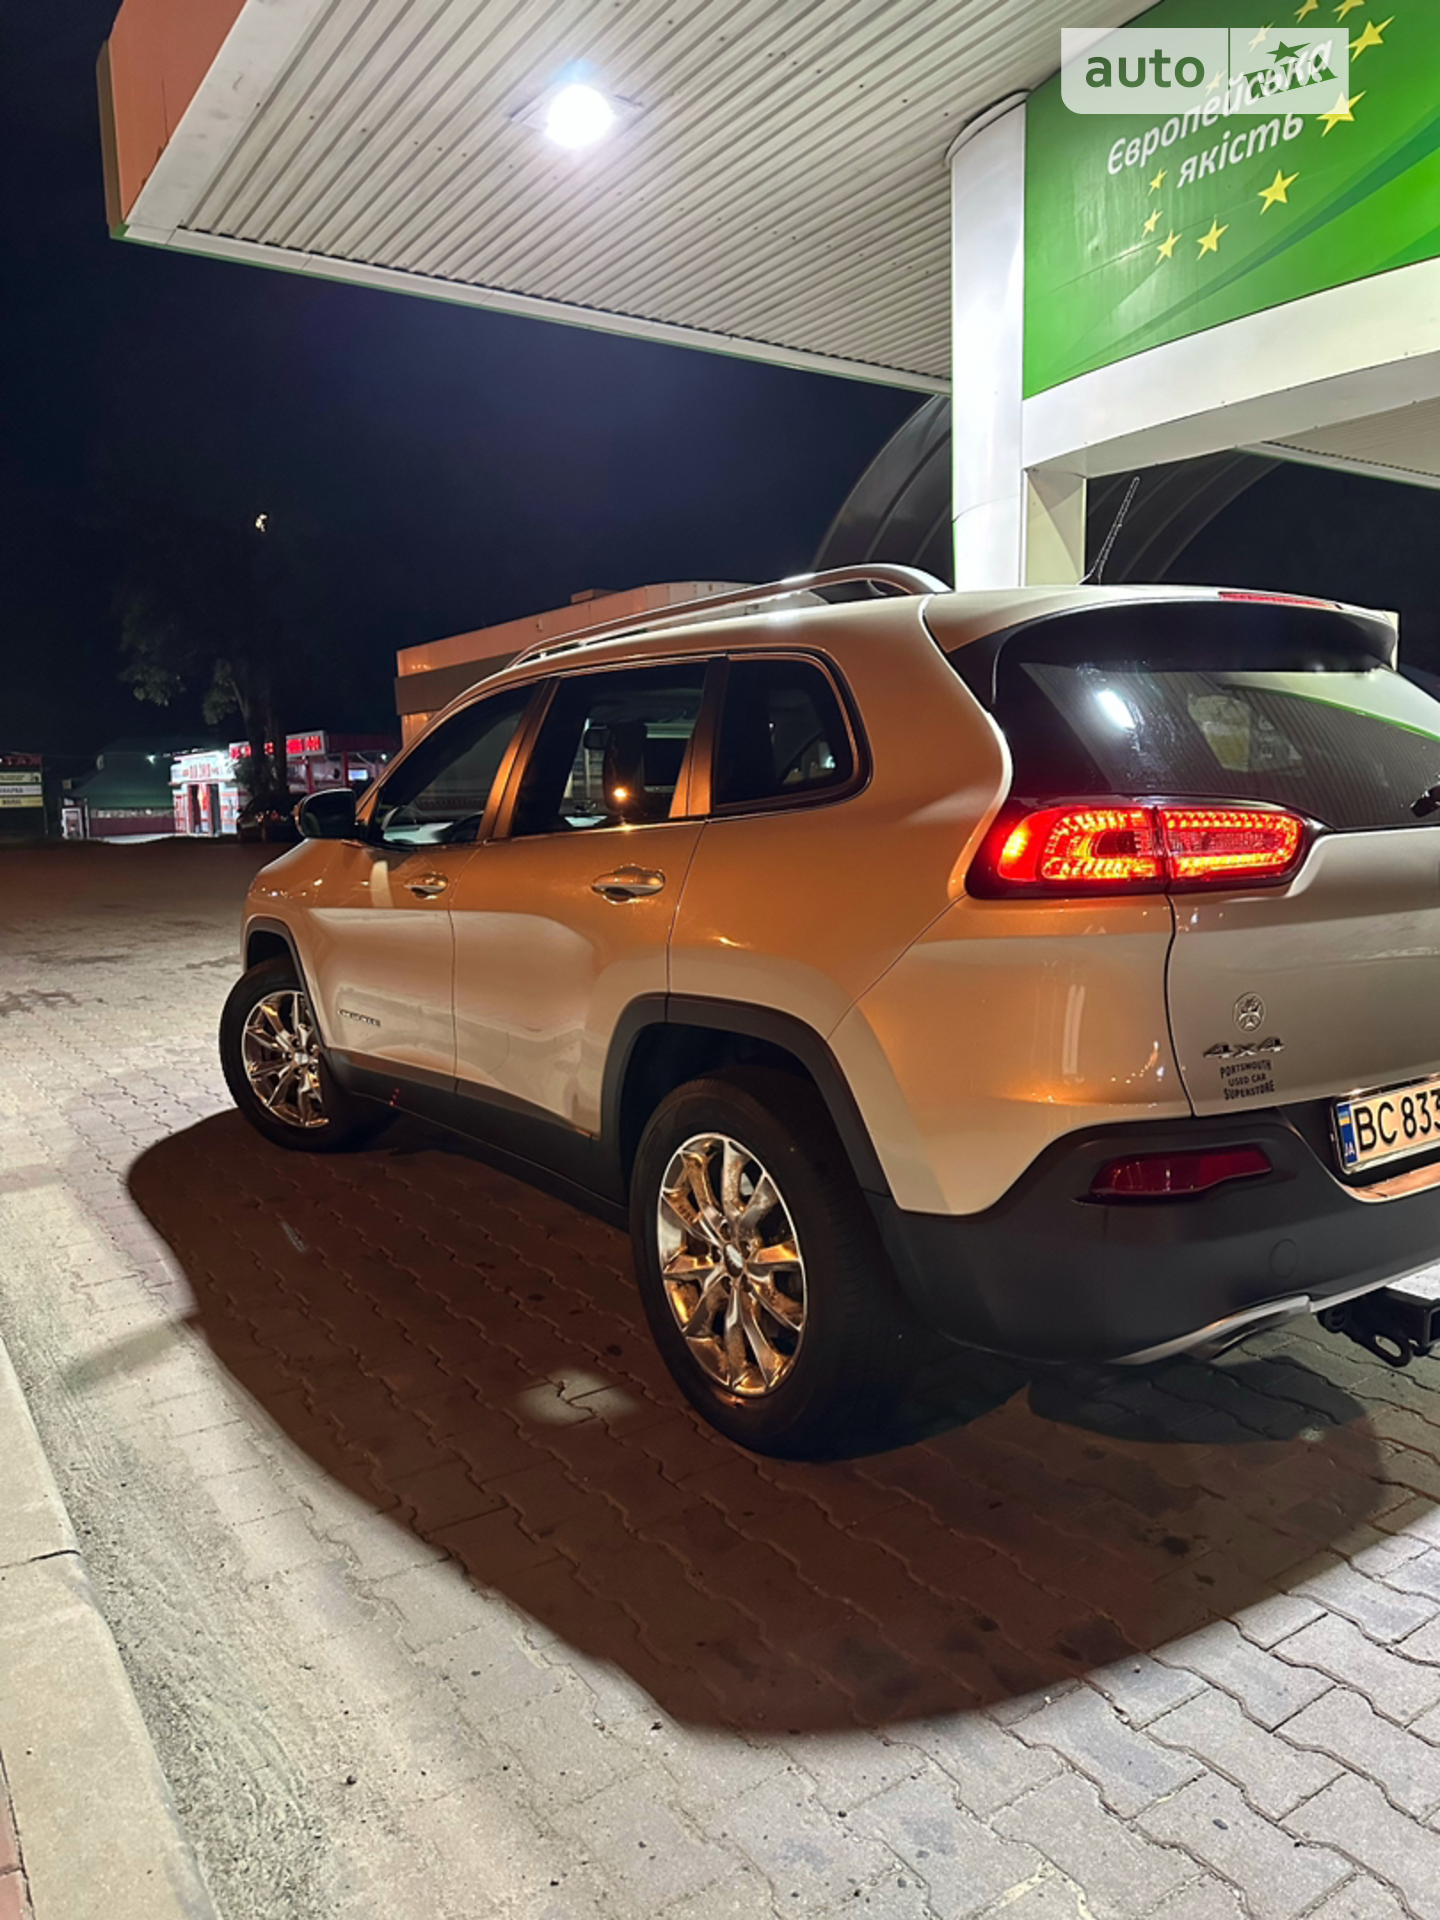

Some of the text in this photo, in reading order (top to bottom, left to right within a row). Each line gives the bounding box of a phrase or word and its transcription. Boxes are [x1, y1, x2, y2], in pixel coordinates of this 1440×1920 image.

[1107, 38, 1334, 175] Європейська
[1177, 112, 1304, 189] якість
[1220, 1060, 1272, 1079] PORTSMOUTH
[1228, 1073, 1267, 1087] USED CAR
[1223, 1080, 1275, 1101] SUPERSTORE
[1353, 1101, 1397, 1151] BC
